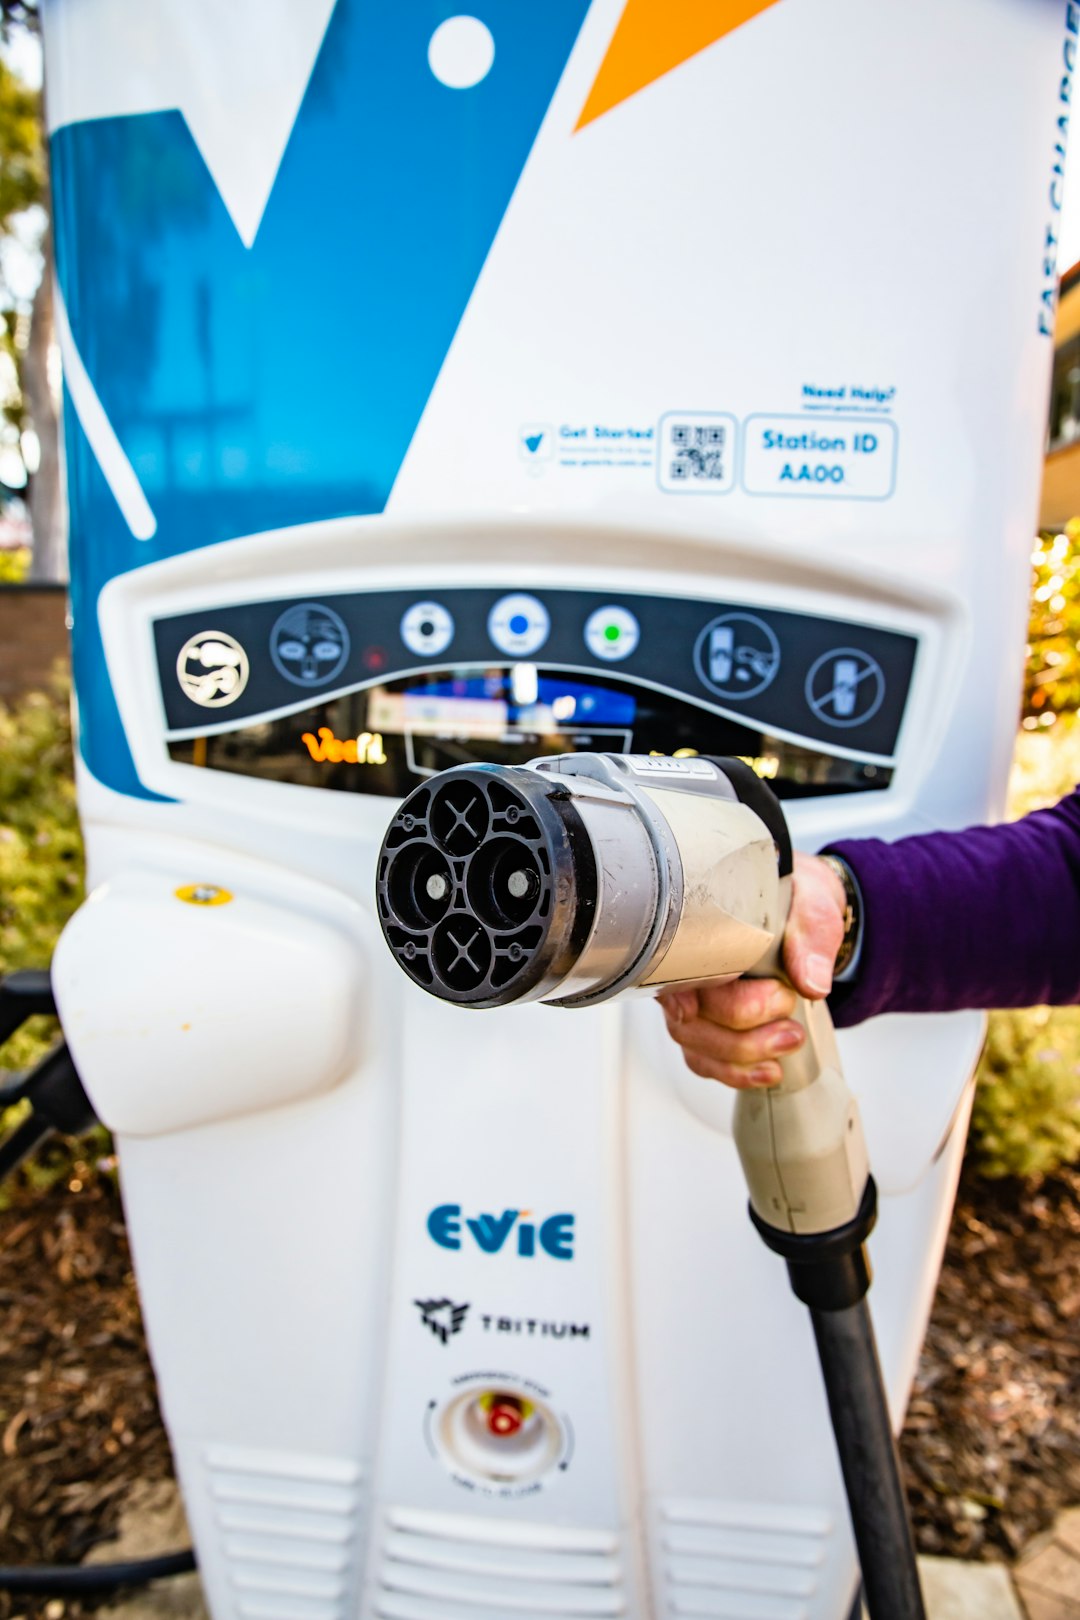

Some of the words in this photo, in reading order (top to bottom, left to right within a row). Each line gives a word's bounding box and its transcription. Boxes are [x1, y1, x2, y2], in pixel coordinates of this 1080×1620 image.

[802, 385, 845, 398] Need
[851, 386, 896, 403] Help?
[560, 424, 586, 438] Get
[594, 424, 653, 438] Started
[762, 429, 845, 452] Station
[853, 431, 878, 454] ID
[480, 1315, 591, 1340] TRITIUM
